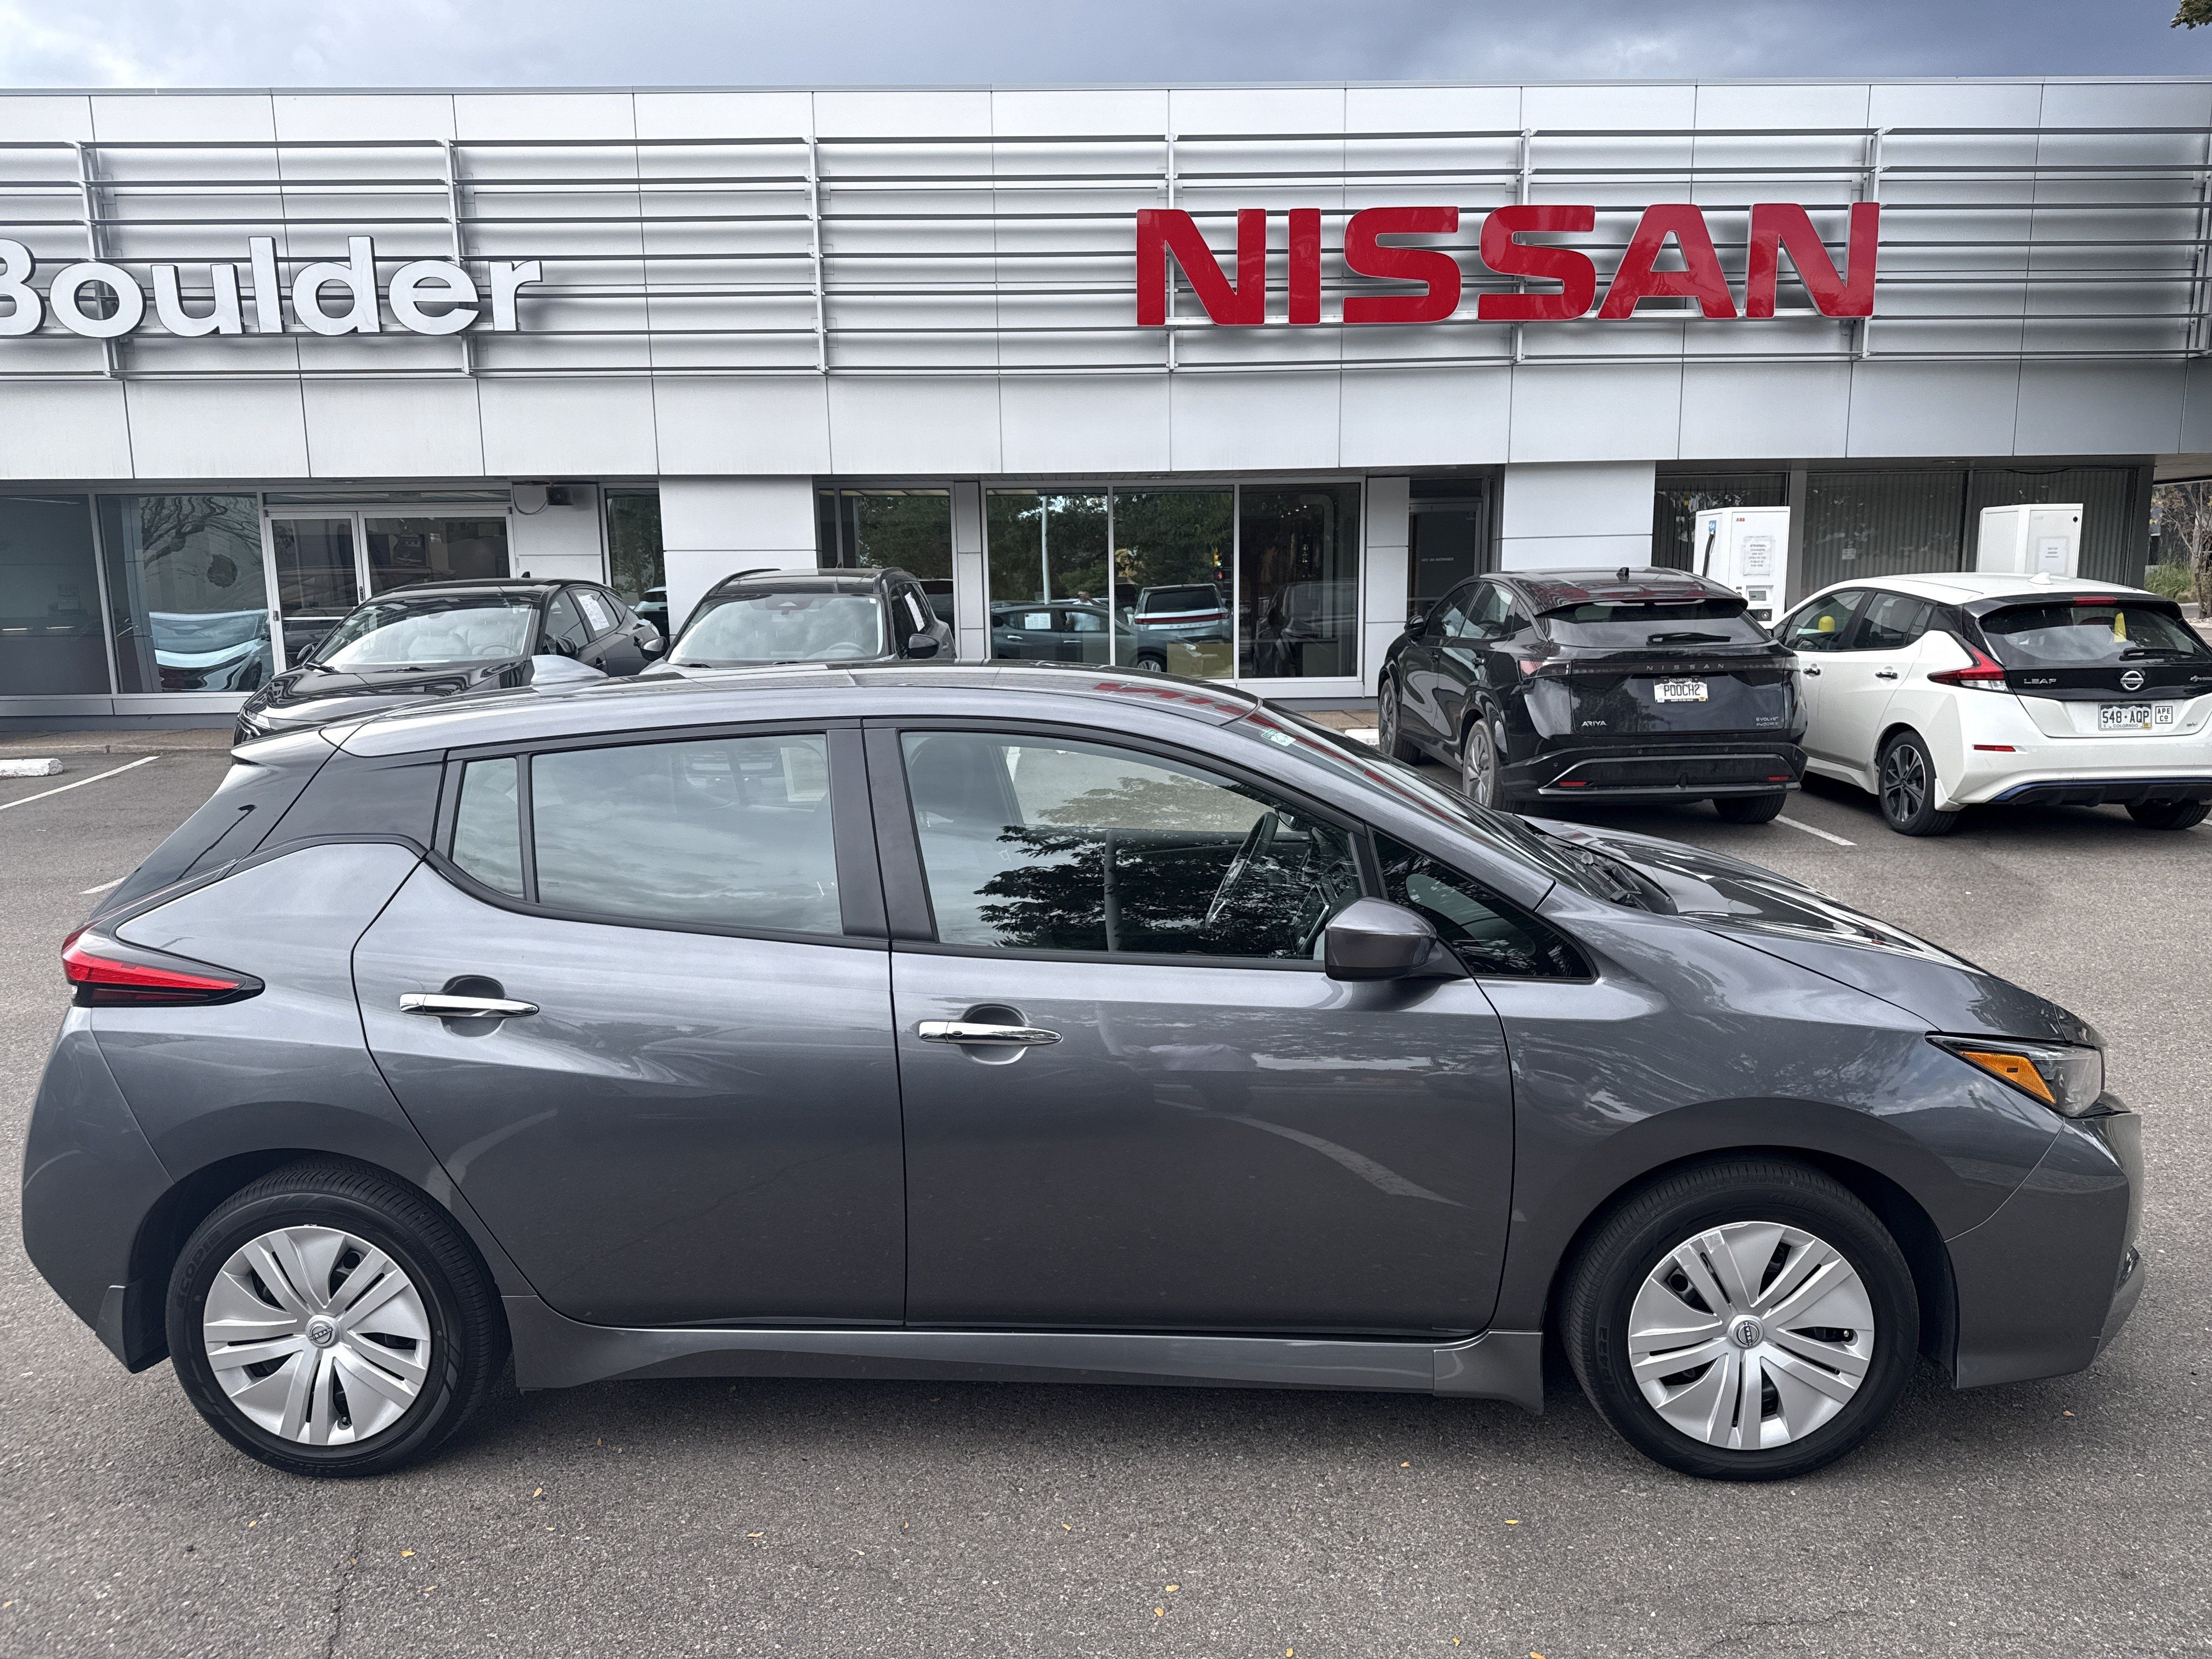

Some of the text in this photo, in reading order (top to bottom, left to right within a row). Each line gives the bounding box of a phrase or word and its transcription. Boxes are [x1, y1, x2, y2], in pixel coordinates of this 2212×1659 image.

[1136, 202, 1881, 326] NISSAN
[1646, 663, 1724, 671] NISSAN
[1663, 684, 1701, 696] POOCH2
[309, 1326, 334, 1340] NISSAN
[1744, 1321, 1753, 1347] NISSAN
